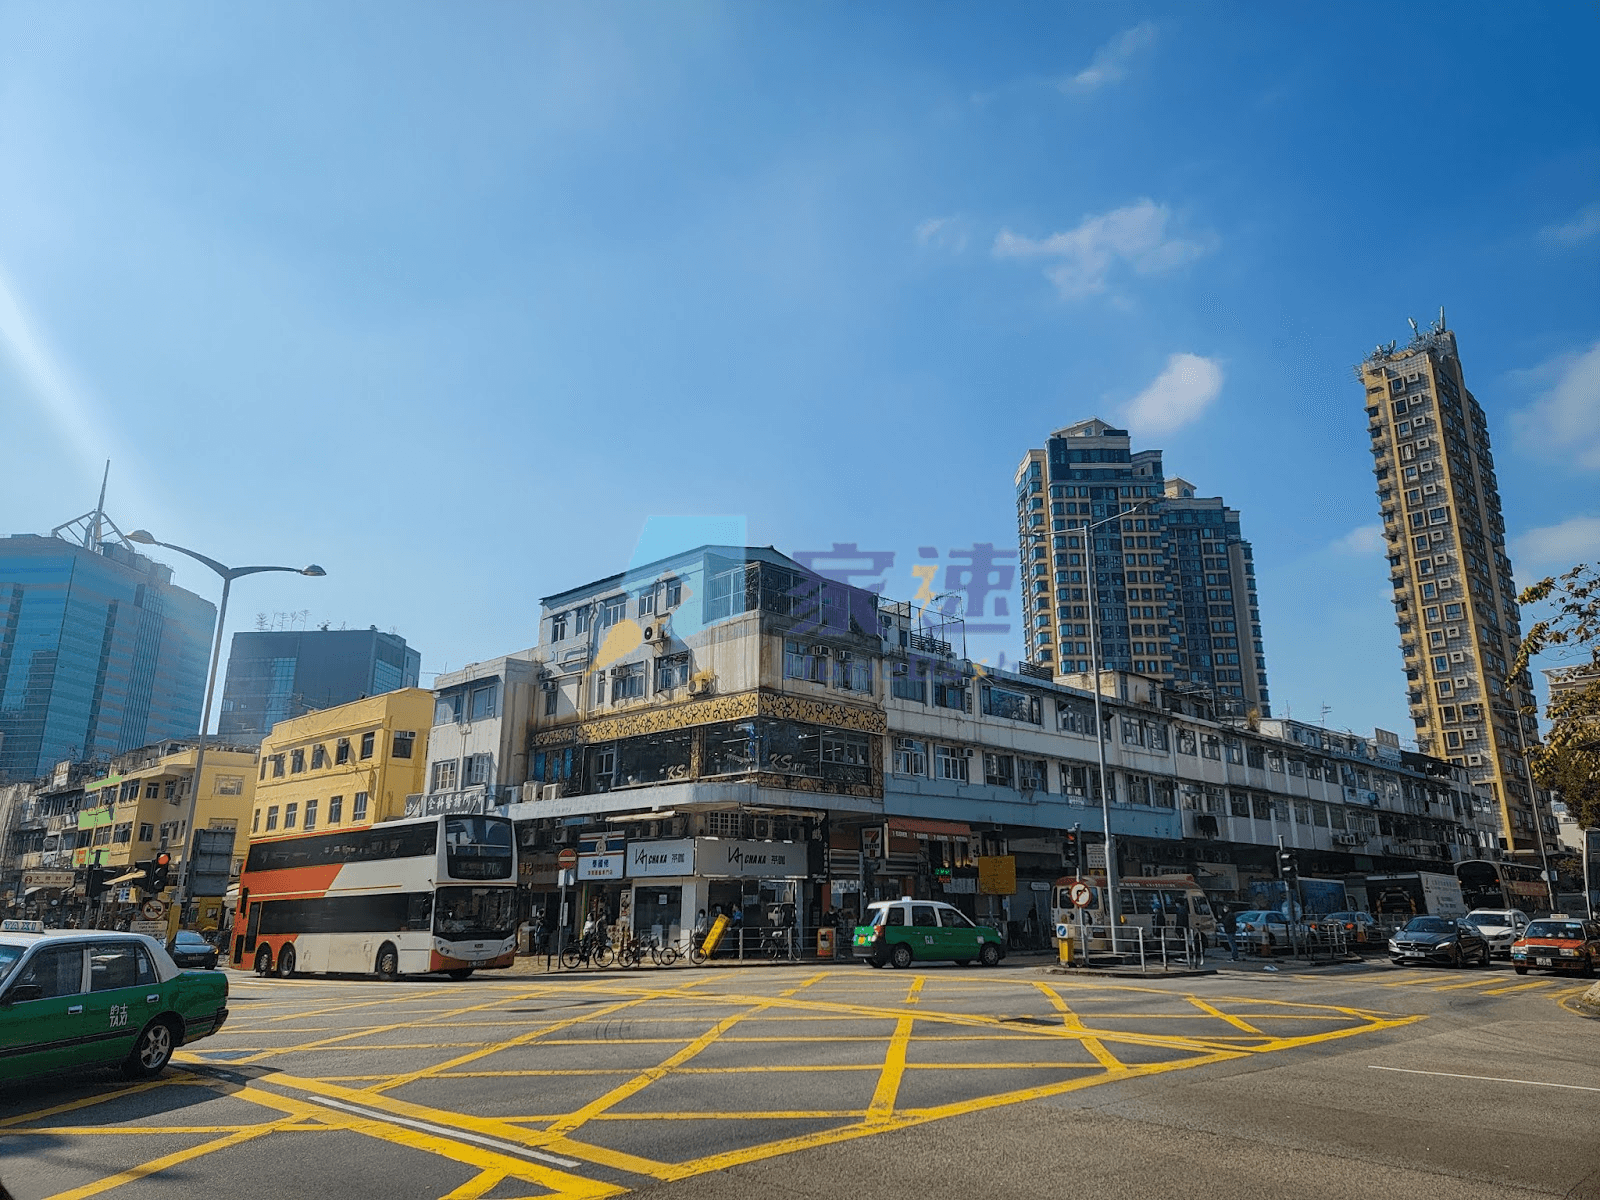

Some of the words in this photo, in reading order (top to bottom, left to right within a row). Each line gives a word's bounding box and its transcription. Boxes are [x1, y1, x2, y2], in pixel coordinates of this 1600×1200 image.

[4, 921, 37, 931] TAXI
[110, 1003, 128, 1015] 的士
[110, 1014, 127, 1027] TAXI
